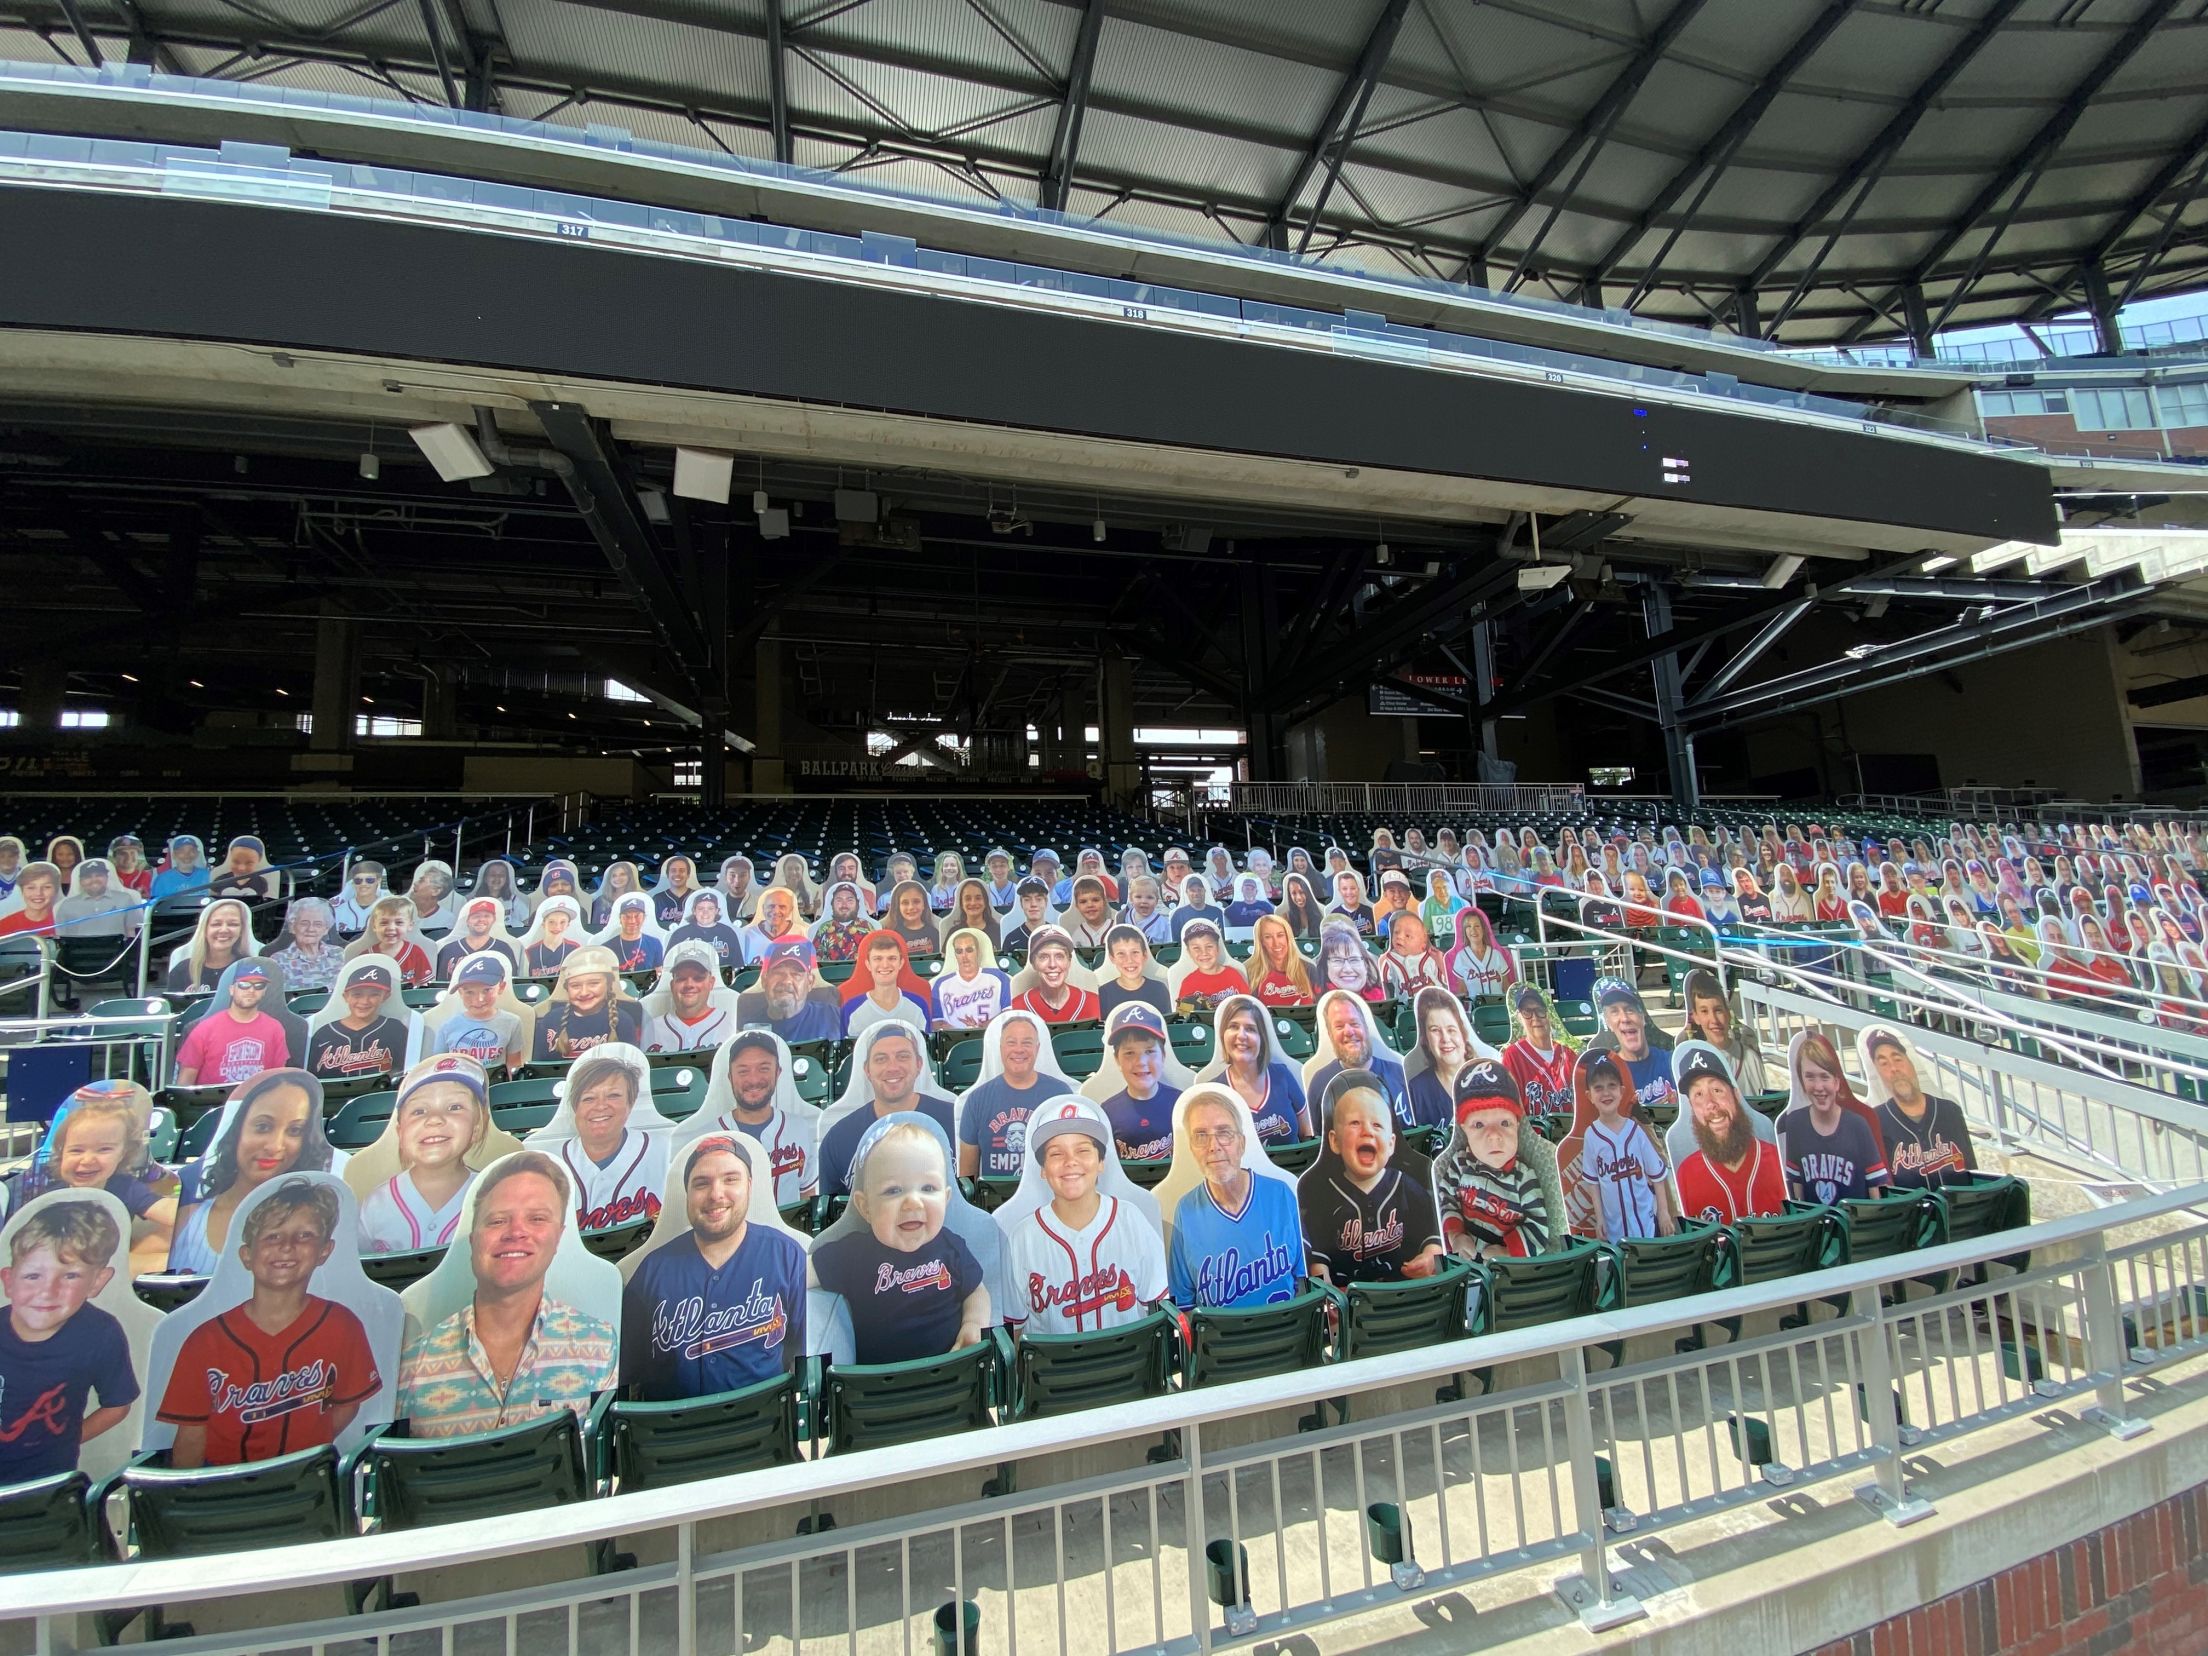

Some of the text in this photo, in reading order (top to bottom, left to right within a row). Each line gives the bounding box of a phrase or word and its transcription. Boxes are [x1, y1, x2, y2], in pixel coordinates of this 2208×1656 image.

[562, 224, 584, 236] 317
[1127, 309, 1144, 319] 318
[1548, 373, 1562, 383] 320
[801, 760, 879, 776] BALLPARK
[1436, 916, 1453, 932] 98
[782, 945, 800, 956] A
[249, 965, 263, 974] A
[360, 968, 378, 980] A
[466, 961, 485, 973] A
[944, 986, 995, 1016] Braves
[977, 1004, 990, 1023] 5
[1122, 1006, 1144, 1023] A
[317, 1039, 383, 1072] Atlanta
[1595, 1055, 1608, 1064] A
[1688, 1052, 1708, 1069] A
[1460, 1061, 1498, 1088] A
[771, 1142, 797, 1164] ves
[1892, 1133, 1951, 1175] Atlanta
[1597, 1153, 1635, 1178] Braves
[1801, 1153, 1854, 1187] BRAVES
[1338, 1207, 1404, 1250] tlanta
[875, 1259, 940, 1294] Braves
[1198, 1230, 1293, 1308] Atlanta
[1029, 1263, 1118, 1313] Braves
[651, 1277, 774, 1358] Atlanta
